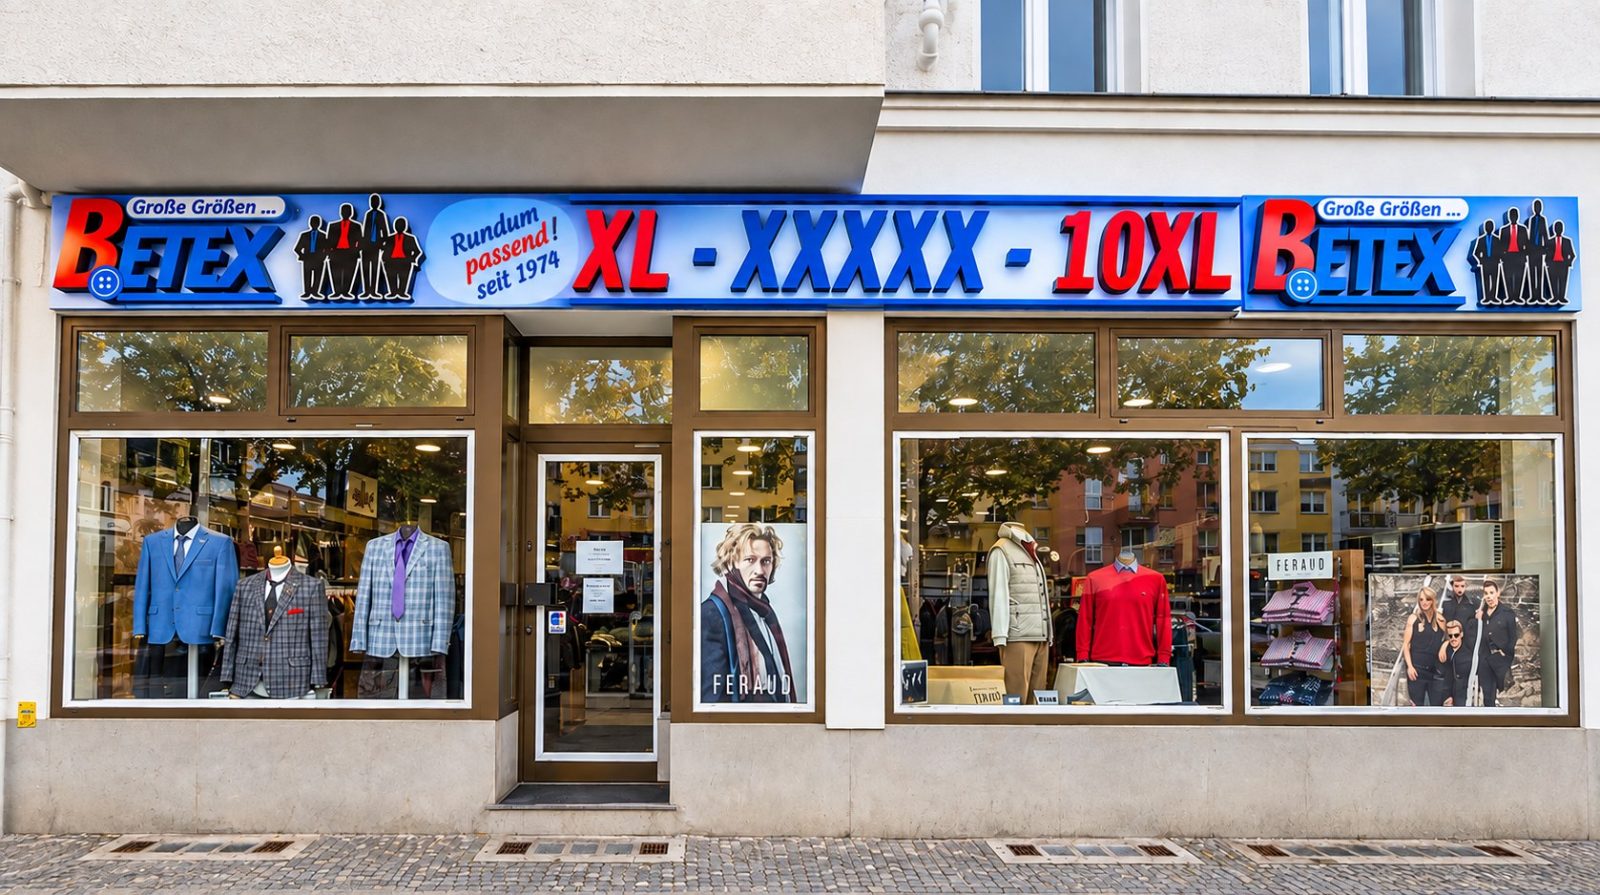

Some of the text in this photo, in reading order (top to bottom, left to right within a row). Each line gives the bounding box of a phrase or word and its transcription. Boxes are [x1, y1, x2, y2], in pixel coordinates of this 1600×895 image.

[132, 198, 187, 215] Große
[191, 198, 256, 215] Größen
[450, 207, 539, 255] Rundum
[1323, 200, 1375, 216] Große
[1380, 200, 1441, 216] Größen
[53, 198, 285, 293] BETEX
[465, 217, 559, 284] passend!
[573, 209, 1232, 294] XL - XXXXX - 10XL
[1248, 198, 1463, 295] BETEX
[477, 249, 560, 301] seit 1974
[1277, 557, 1325, 572] FERAUD
[713, 674, 791, 695] FERAUD
